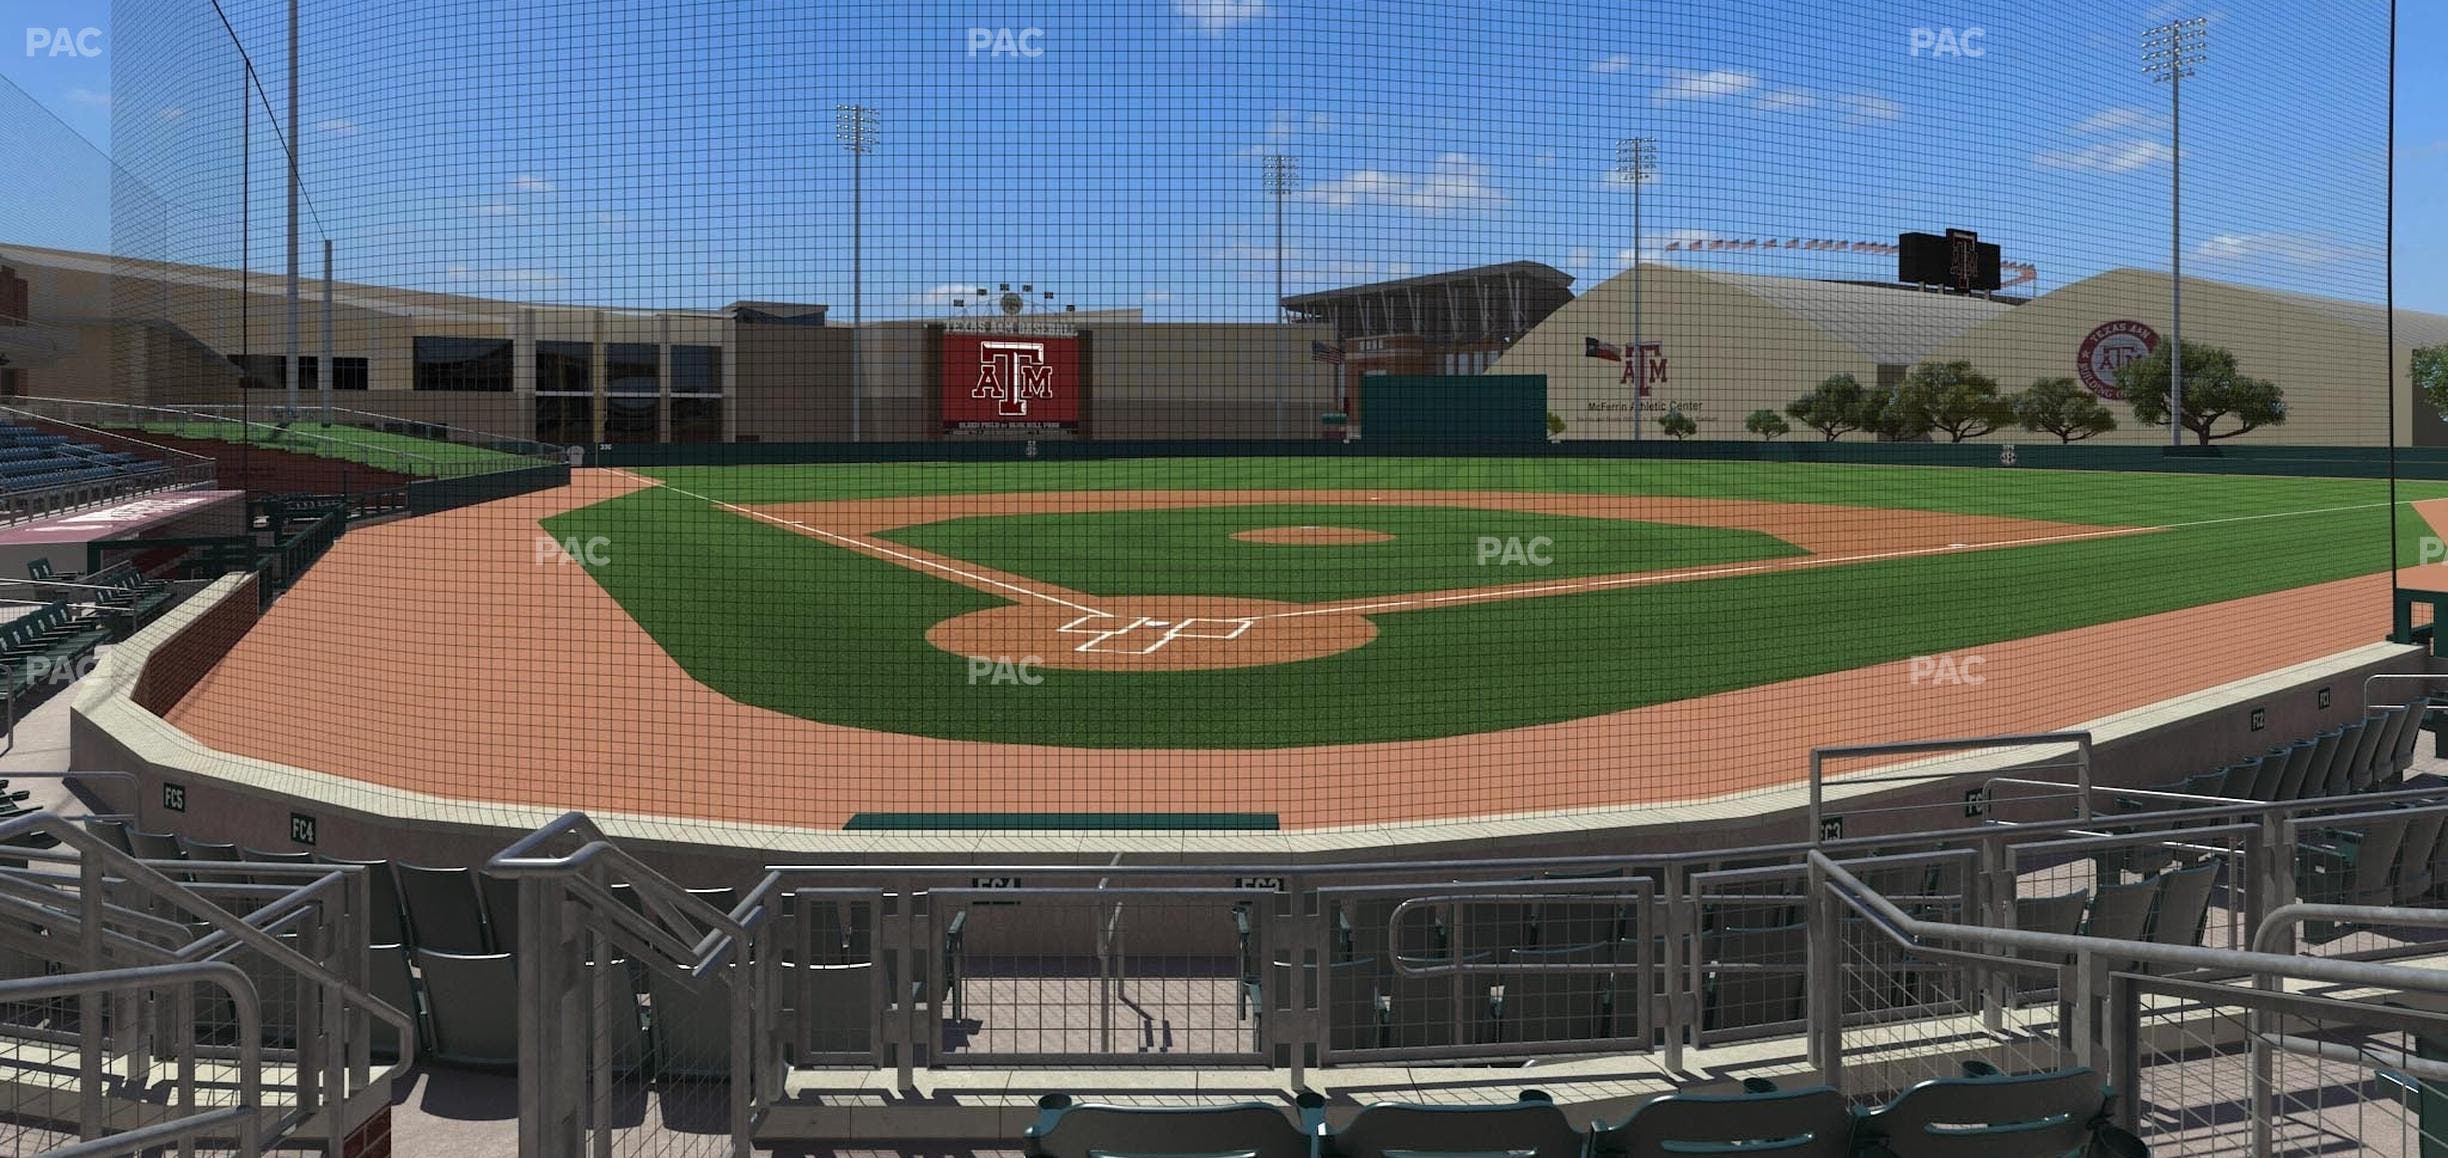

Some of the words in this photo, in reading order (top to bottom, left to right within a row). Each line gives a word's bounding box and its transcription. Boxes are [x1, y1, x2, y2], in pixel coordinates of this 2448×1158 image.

[945, 321, 986, 333] TEXAS
[2089, 322, 2128, 342] TEXAS
[2078, 362, 2114, 399] BUILDING
[1630, 401, 1666, 411] hletic
[1669, 401, 1703, 412] Center
[165, 786, 184, 809] FC5
[292, 817, 314, 842] FC4
[1820, 822, 1841, 841] C3
